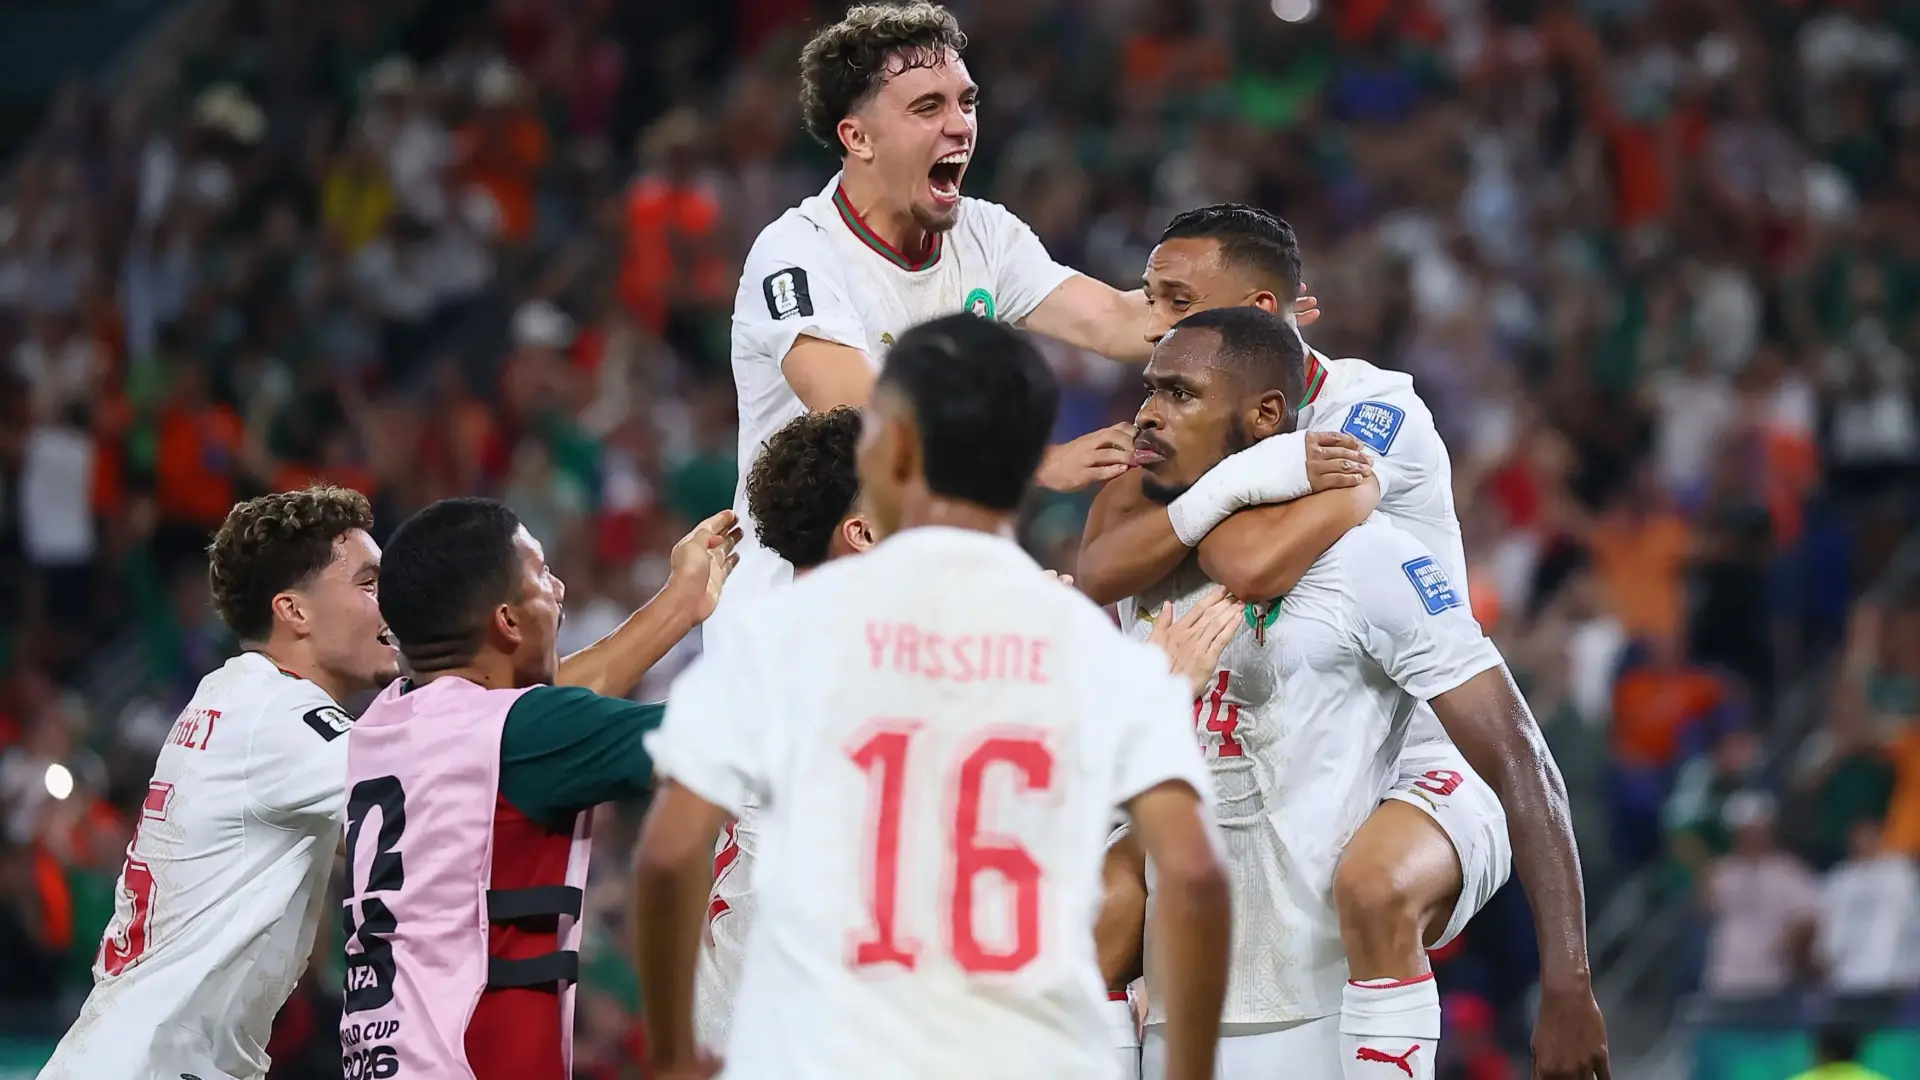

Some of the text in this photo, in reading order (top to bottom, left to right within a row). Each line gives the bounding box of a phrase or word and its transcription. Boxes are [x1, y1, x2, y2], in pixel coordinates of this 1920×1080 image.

[1358, 410, 1393, 430] UNITES
[1361, 404, 1395, 420] FOOTBALL
[1353, 417, 1391, 440] the World
[1360, 428, 1374, 440] FIFA
[865, 618, 1053, 684] YASSINE
[1414, 769, 1464, 797] 9
[843, 718, 1057, 982] 16
[363, 1020, 400, 1041] CUP
[343, 1045, 400, 1080] 2026
